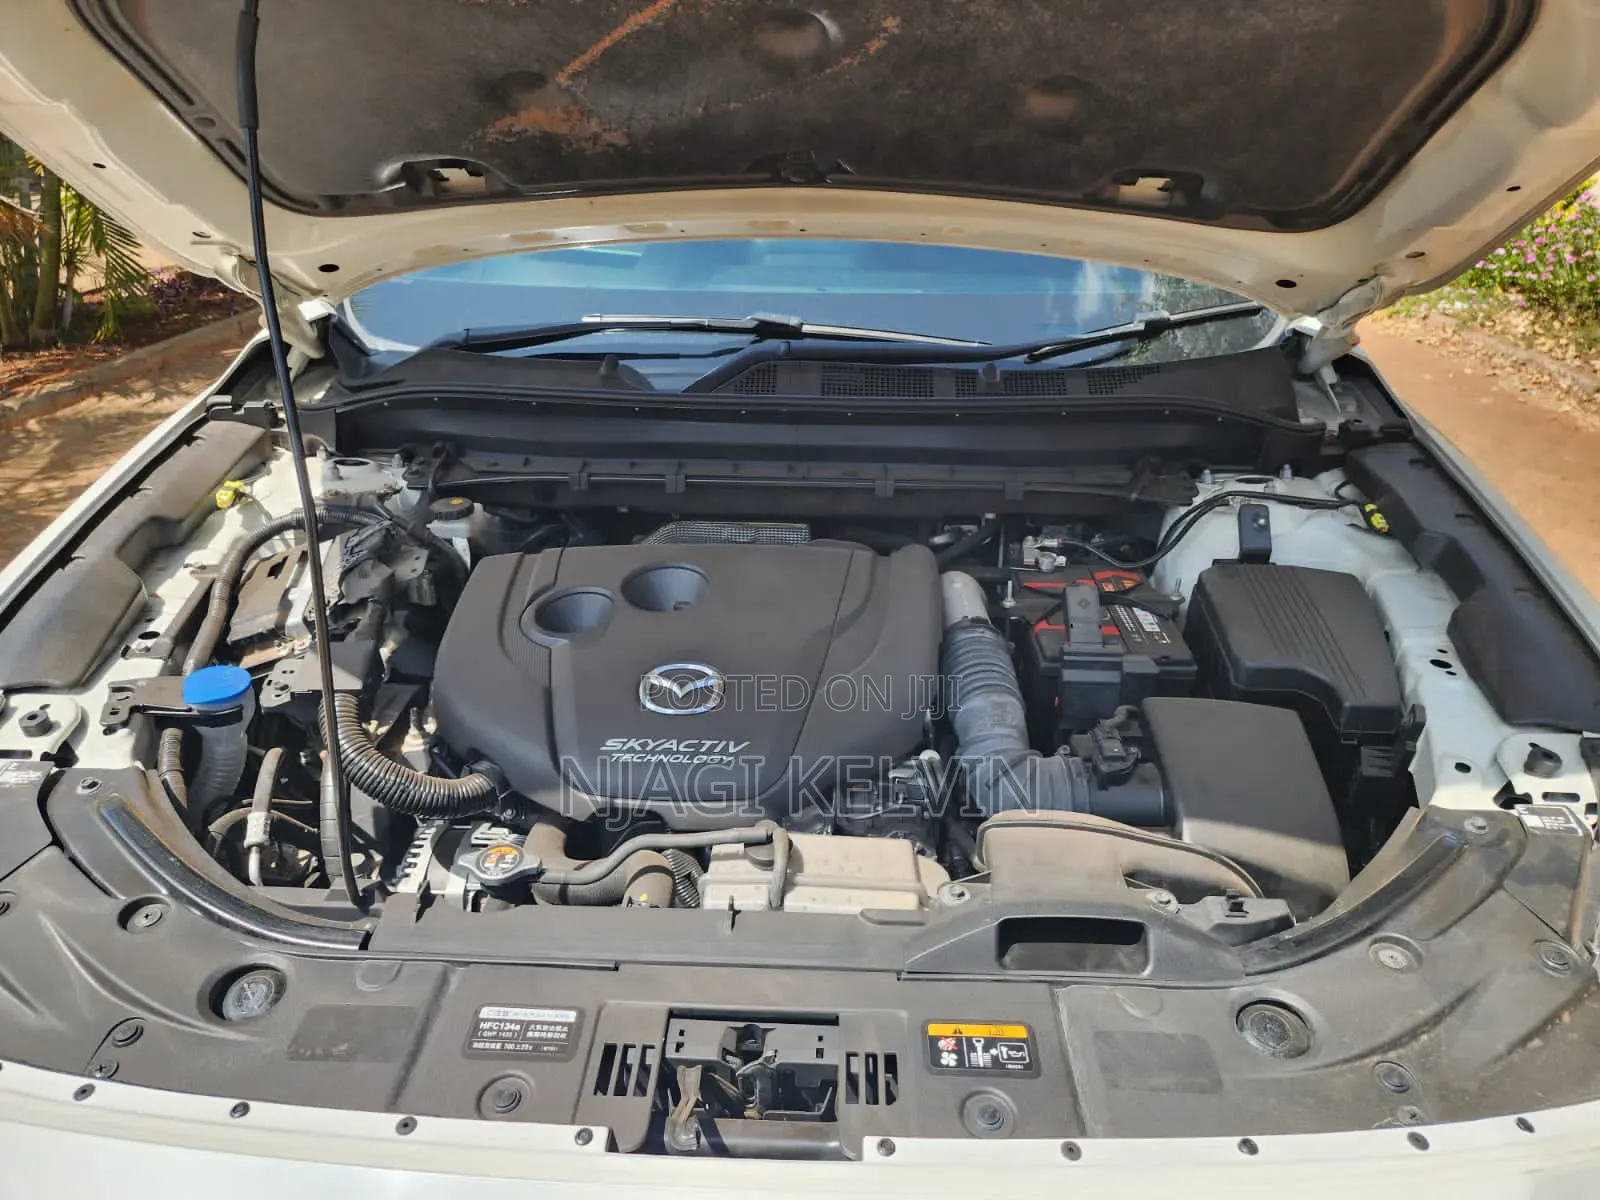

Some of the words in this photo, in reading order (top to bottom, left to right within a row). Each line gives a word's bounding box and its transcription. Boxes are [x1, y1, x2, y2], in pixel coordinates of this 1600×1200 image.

[600, 738, 751, 753] SKYACTIV
[610, 753, 735, 764] TECHNOLOGY
[479, 1021, 521, 1031] HFC134a
